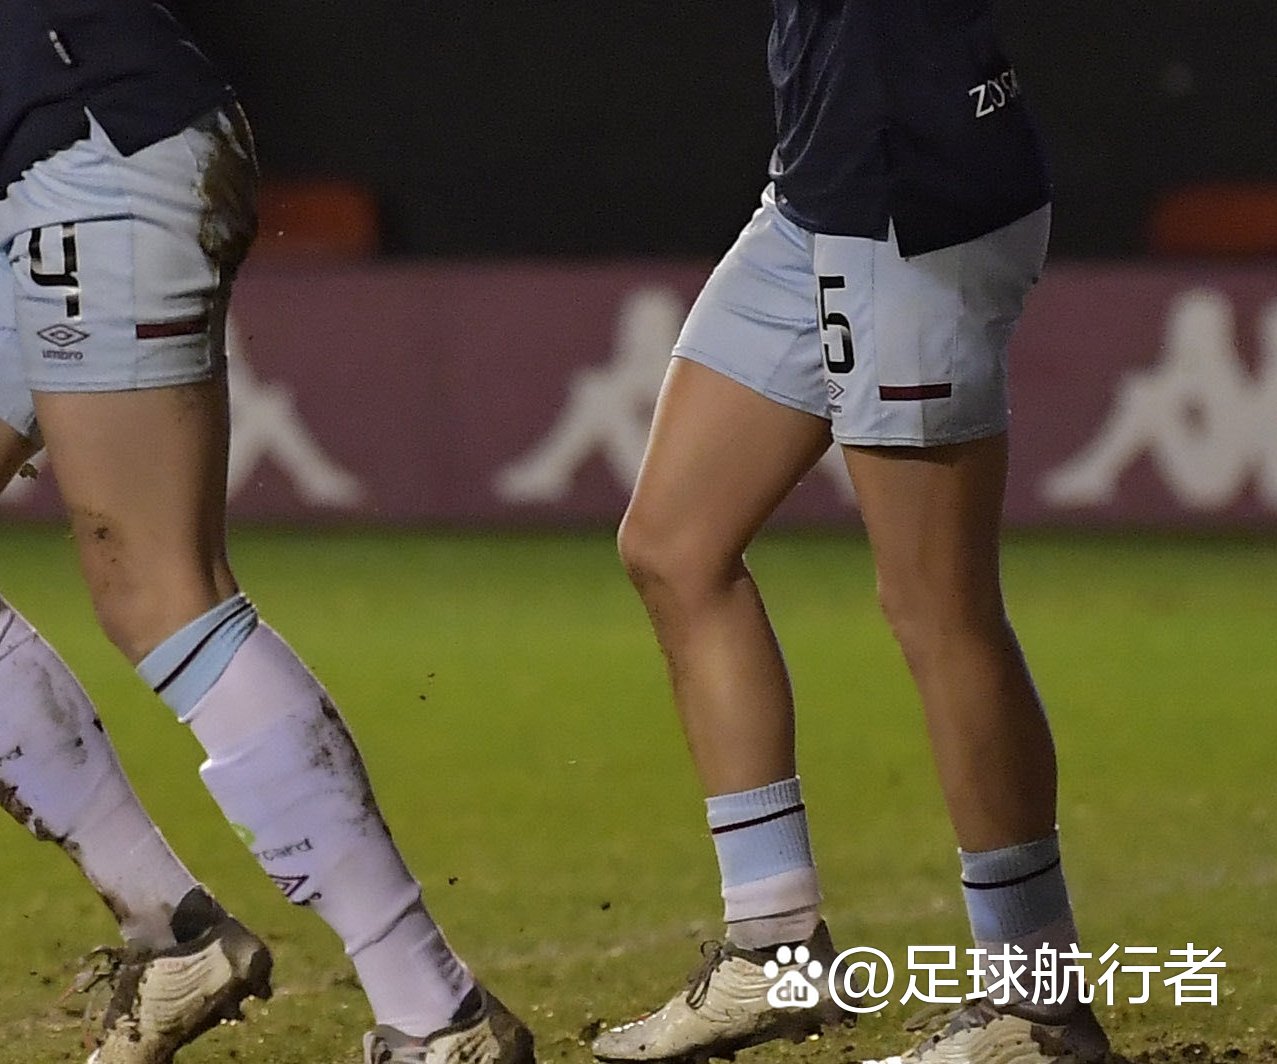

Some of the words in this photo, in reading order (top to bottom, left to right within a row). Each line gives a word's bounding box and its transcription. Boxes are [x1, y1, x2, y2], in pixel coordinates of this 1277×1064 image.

[28, 222, 80, 318] 4
[42, 350, 84, 361] umbro
[818, 276, 855, 374] 5
